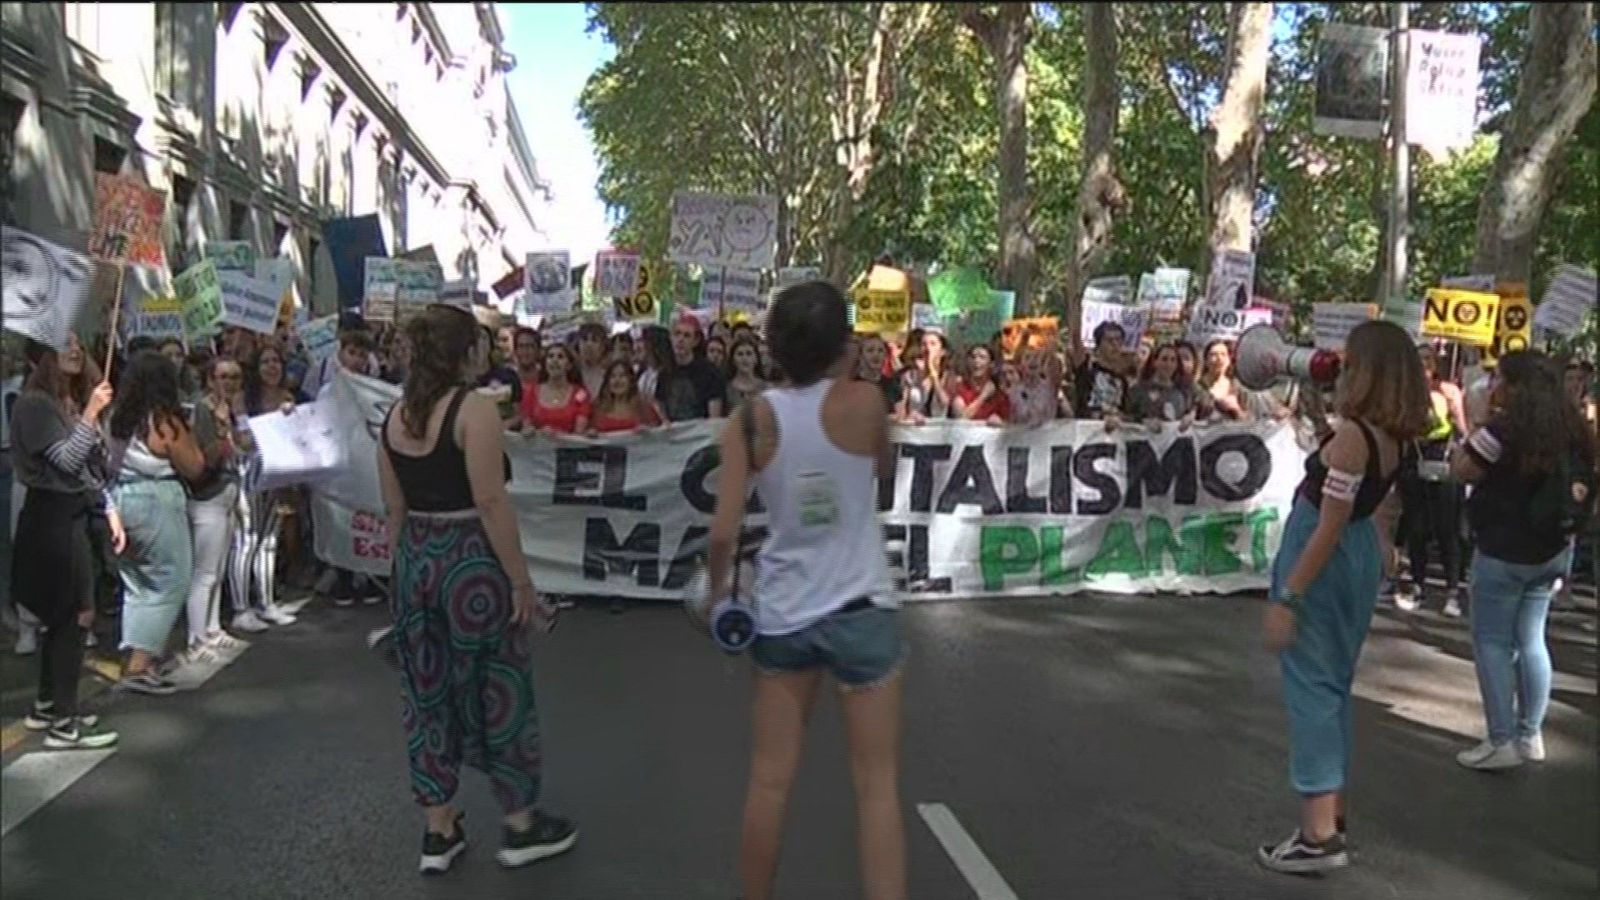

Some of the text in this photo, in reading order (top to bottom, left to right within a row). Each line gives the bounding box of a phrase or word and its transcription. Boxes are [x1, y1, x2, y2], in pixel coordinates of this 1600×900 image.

[1423, 296, 1494, 328] NO!
[552, 446, 648, 511] EL
[680, 432, 1273, 516] CITALISMO
